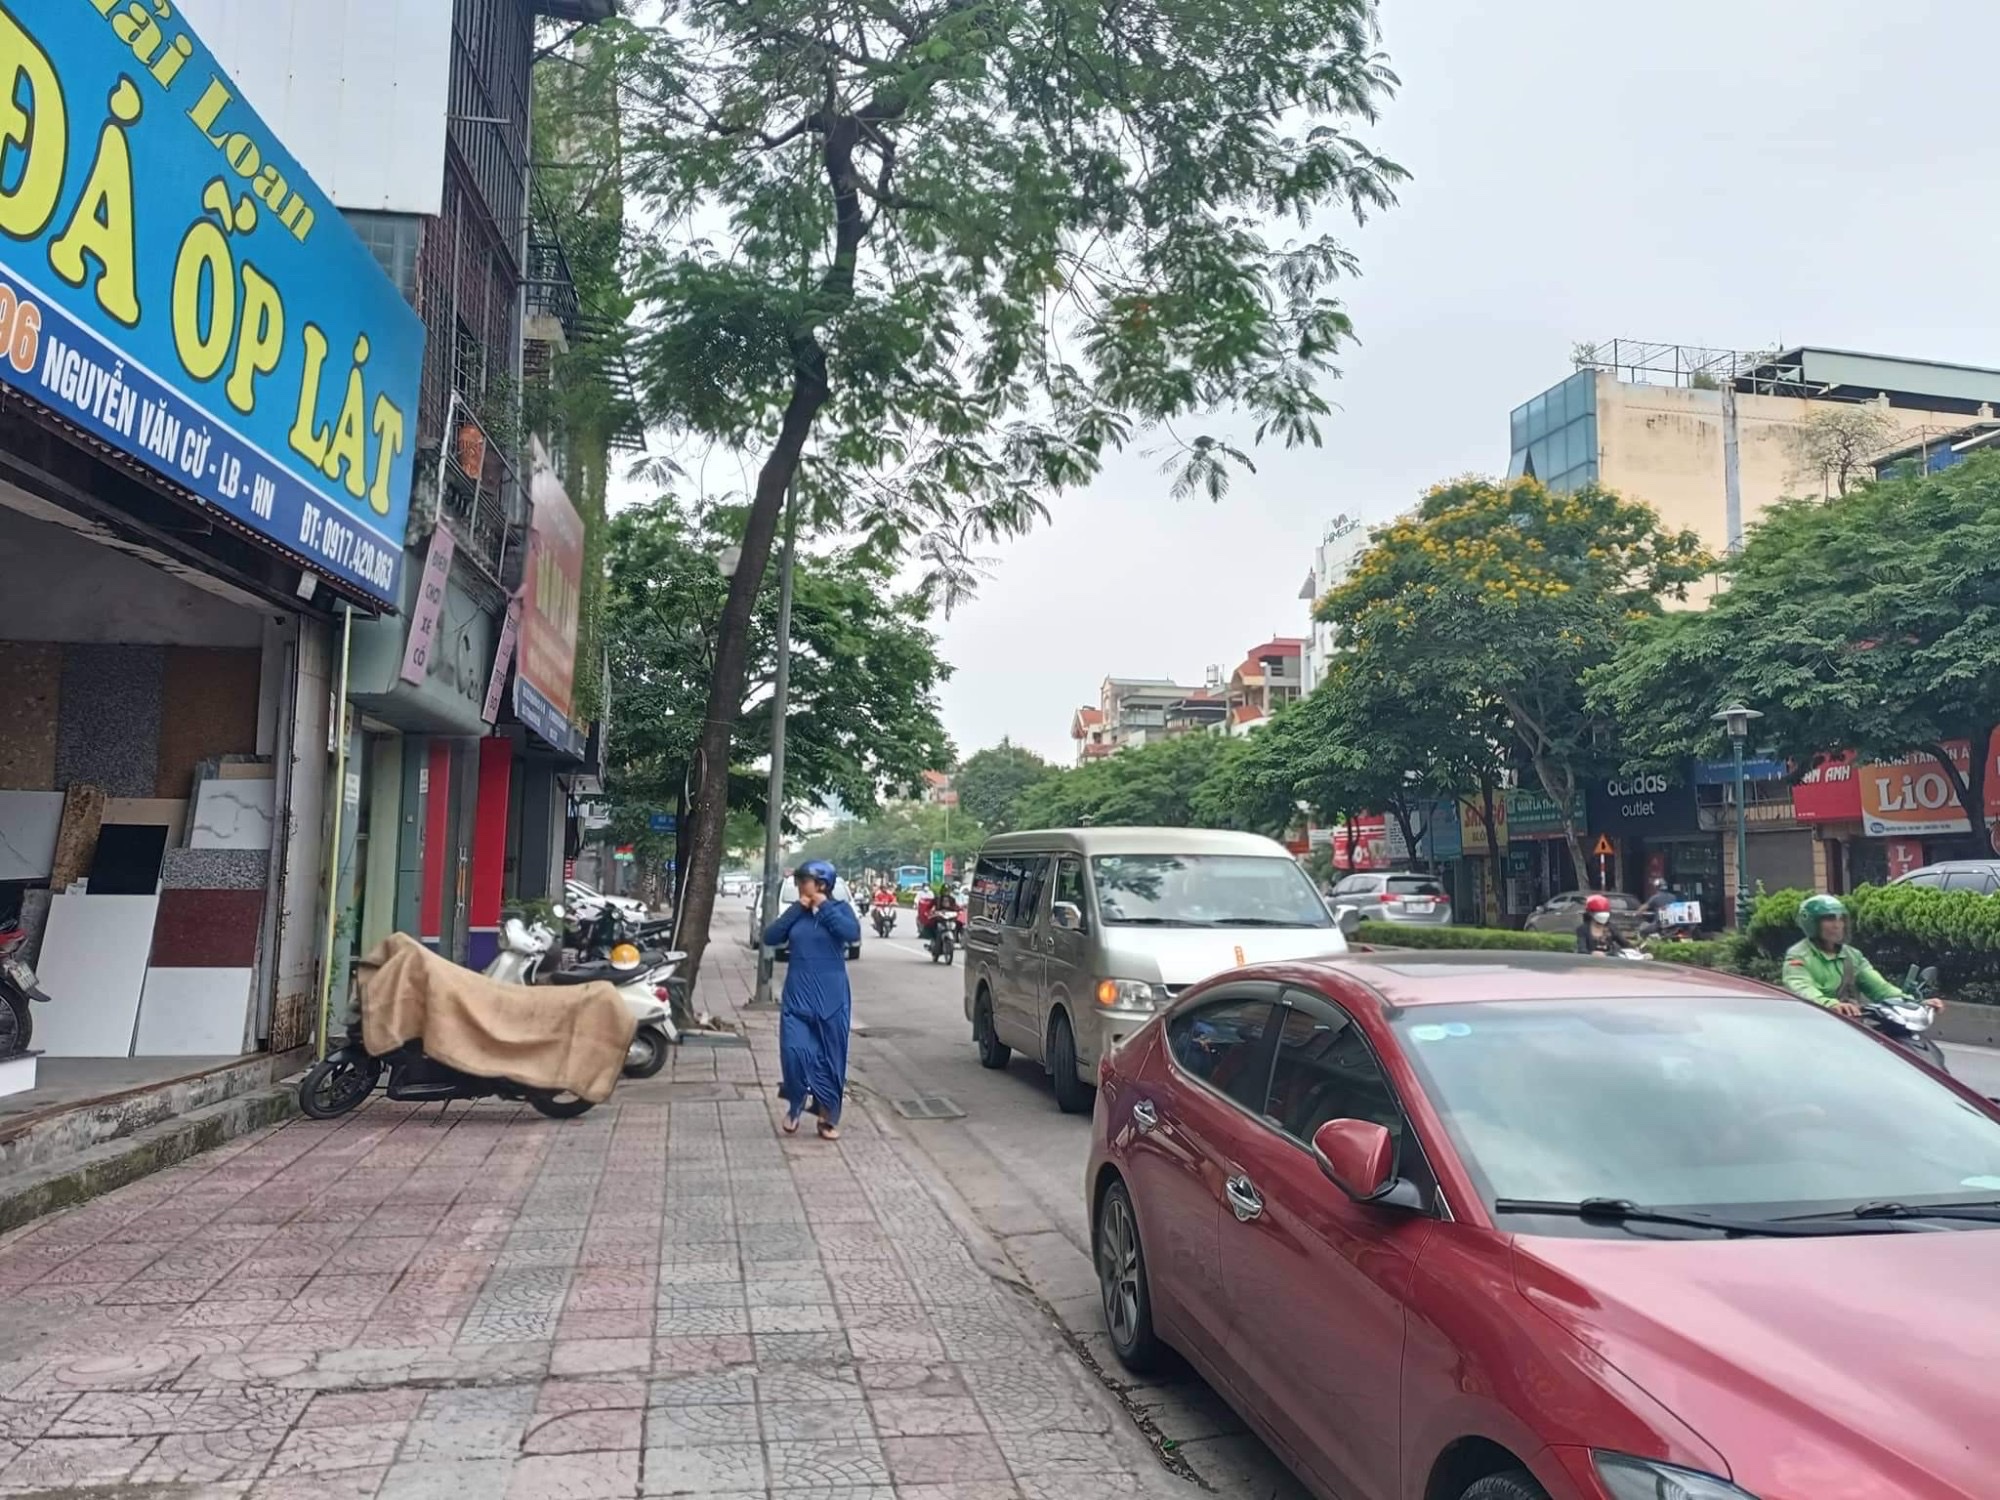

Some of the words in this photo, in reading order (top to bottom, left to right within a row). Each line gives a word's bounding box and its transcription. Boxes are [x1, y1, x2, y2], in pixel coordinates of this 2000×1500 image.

[186, 73, 316, 243] Loan
[41, 336, 137, 436] NGUYỄN
[138, 398, 181, 468] VĂN
[180, 426, 211, 479] CỪ
[218, 453, 240, 499] LB
[251, 473, 275, 521] HN
[171, 175, 285, 415] ỐP
[288, 322, 403, 515] LÁT
[1621, 800, 1655, 817] outlet
